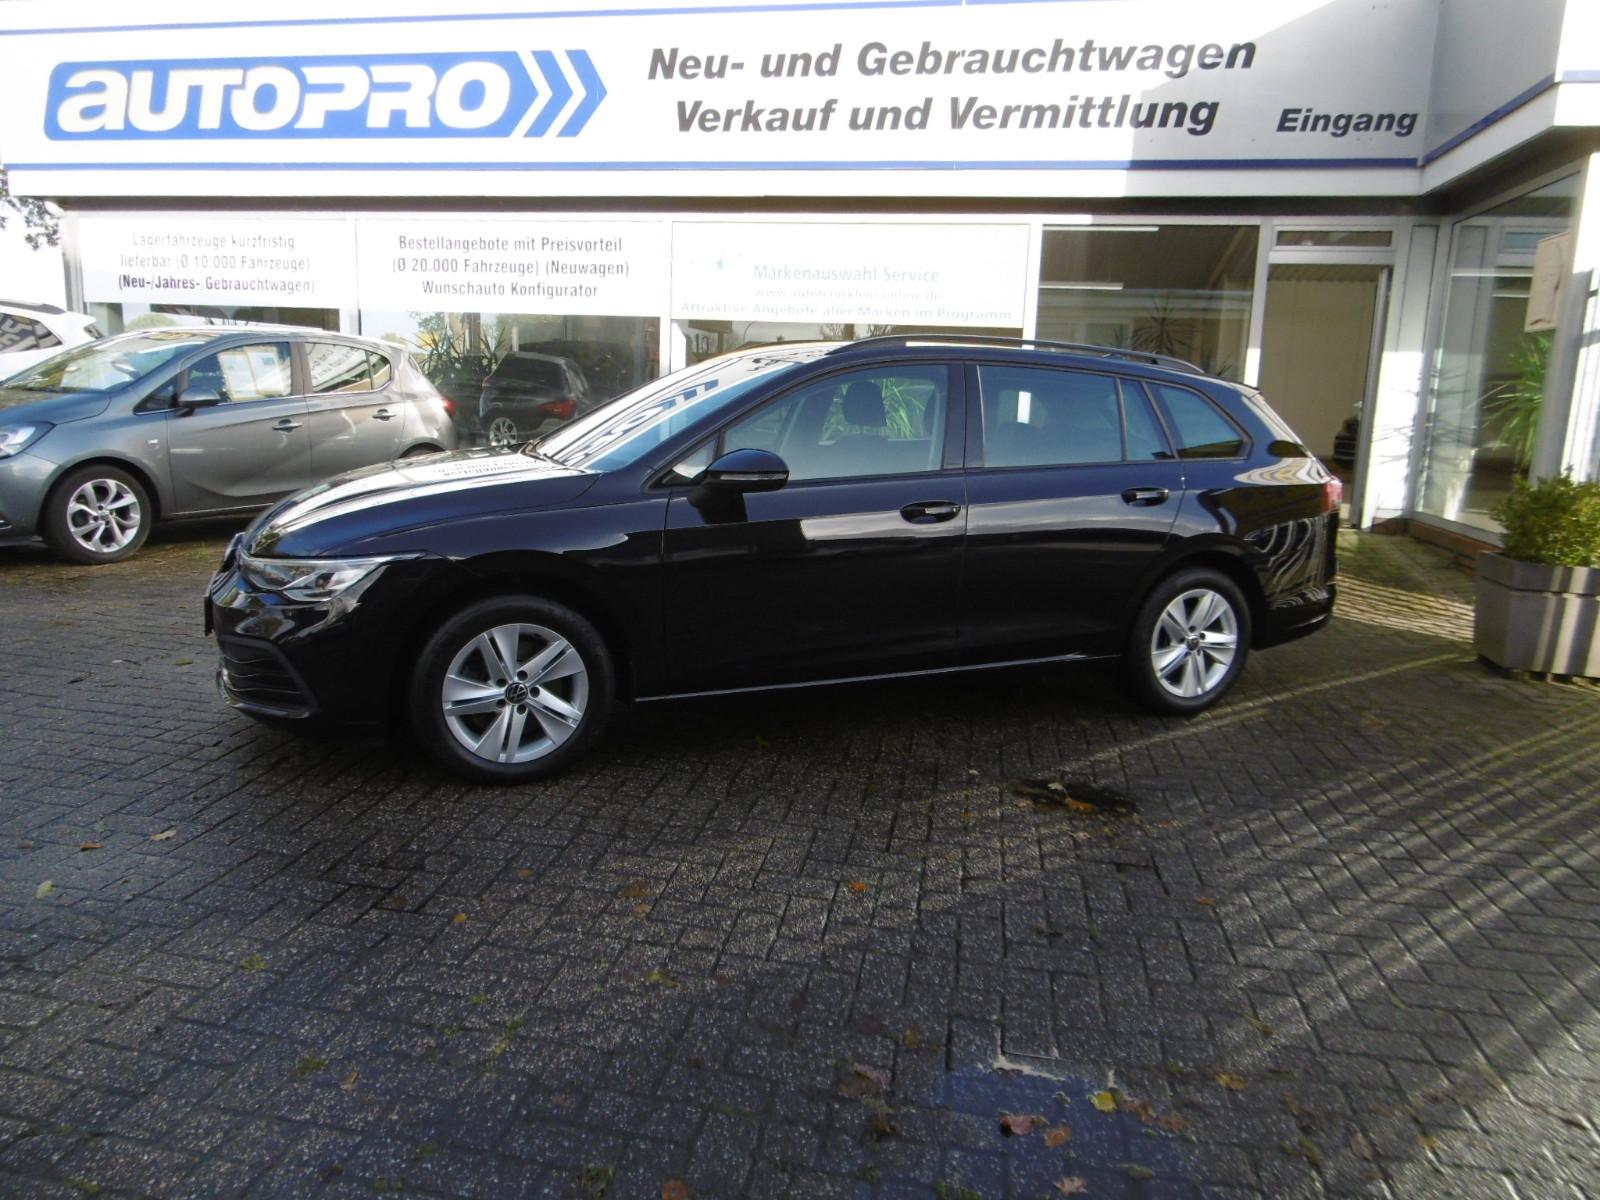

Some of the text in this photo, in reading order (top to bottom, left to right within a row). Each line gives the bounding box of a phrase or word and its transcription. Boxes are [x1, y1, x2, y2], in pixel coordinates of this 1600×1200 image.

[648, 38, 1257, 80] Neu- und Gebrauchtwagen
[677, 94, 1220, 136] Verkauf und Vermittlung
[1276, 108, 1418, 137] Eingang
[132, 232, 295, 251] Lagerfahrzeuge kurzfristig
[399, 235, 623, 253] Bestellangebote mit Preisvorteil
[120, 254, 171, 269] lieferbar
[194, 255, 236, 269] 10.000
[241, 255, 311, 273] Fahrzeuge)
[412, 258, 458, 272] 20.000
[464, 259, 540, 276] Fahrzeuge)
[546, 260, 630, 277] (Neuwagen)
[753, 264, 940, 283] Markenauswahl Service
[423, 280, 598, 299] Wunschauto Konfigurator
[680, 301, 1013, 321] Attraktive Angebote aller Marken im Programm
